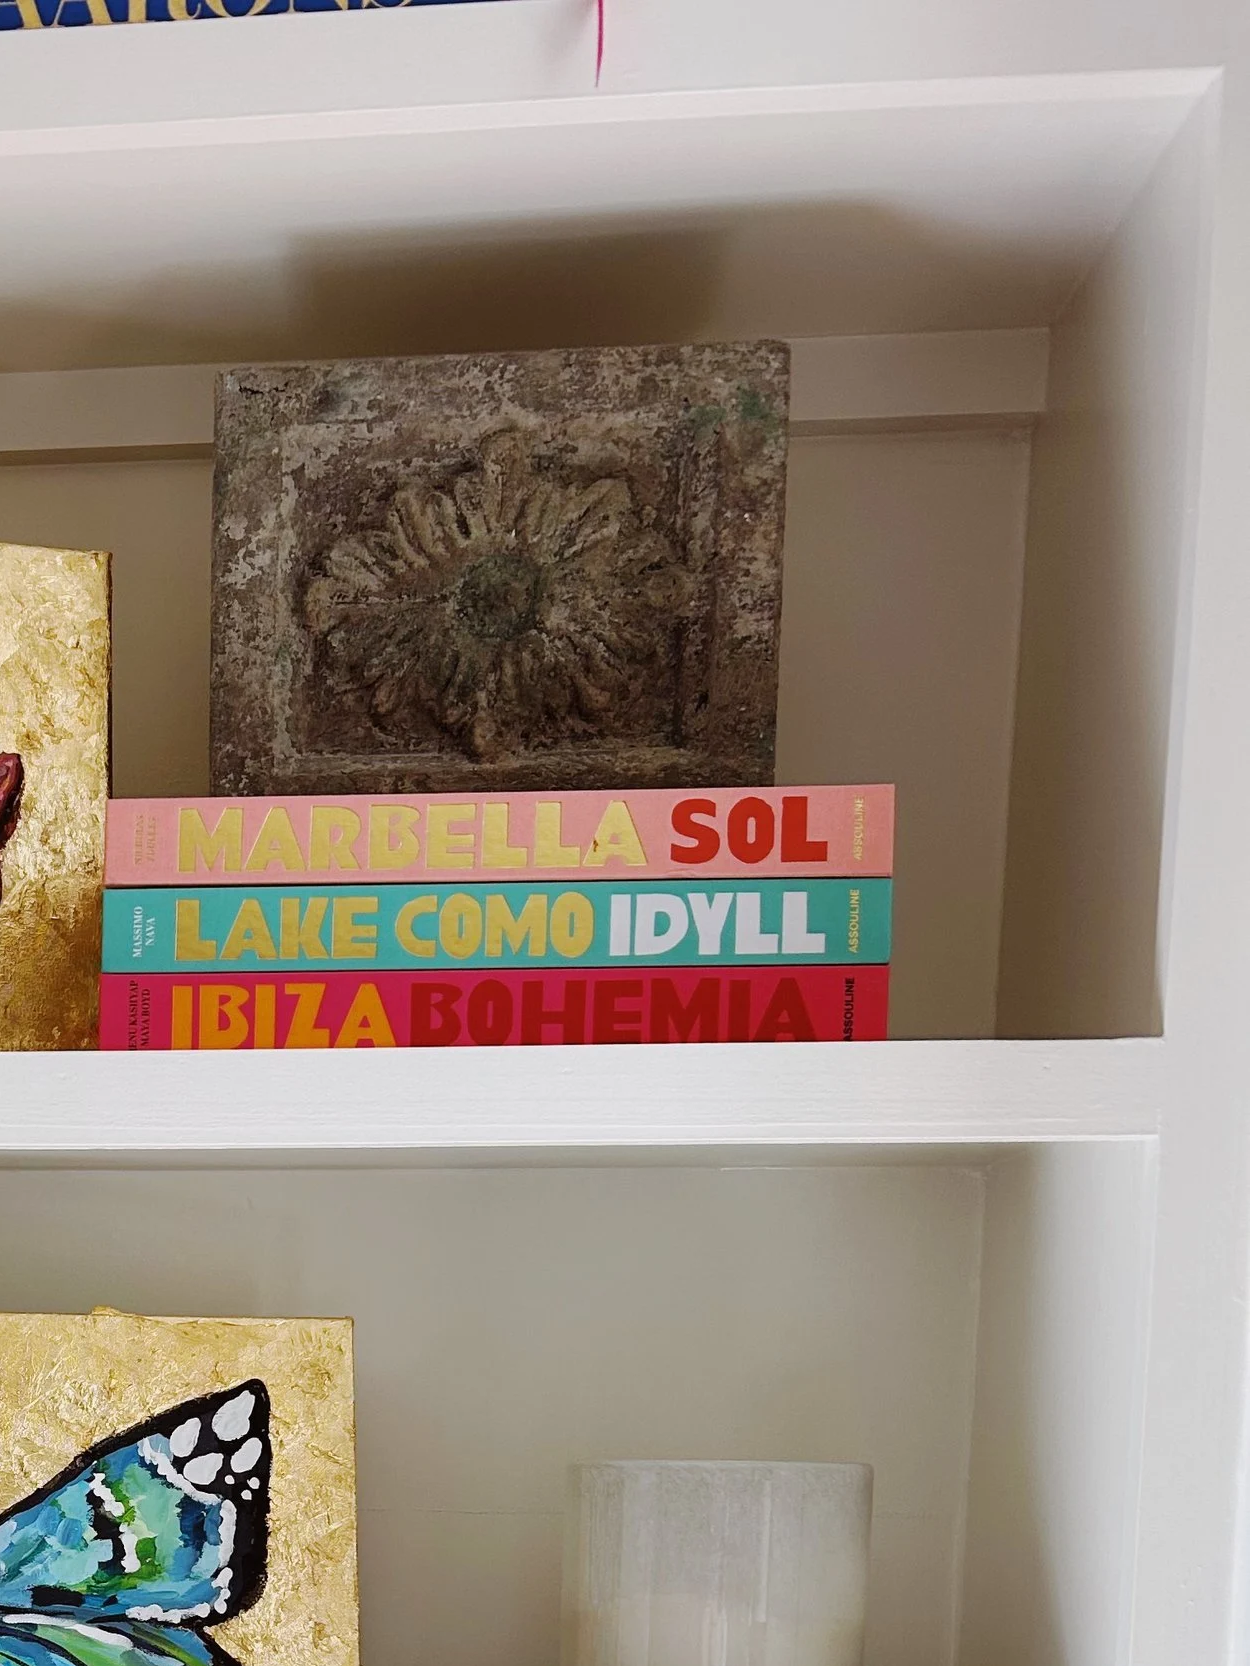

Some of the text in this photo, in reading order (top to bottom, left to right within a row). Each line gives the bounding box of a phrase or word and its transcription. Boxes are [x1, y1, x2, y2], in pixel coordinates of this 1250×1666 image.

[178, 800, 649, 873] MARBELLA
[670, 796, 829, 865] SOL
[853, 796, 865, 861] ASSOULINE
[132, 906, 144, 959] MASSIMO
[145, 916, 157, 947] NAVA
[174, 891, 827, 962] LAKE COMO IDYLL
[846, 889, 861, 954] ASSOULINE
[140, 988, 152, 1047] MAYA BOYD
[171, 977, 818, 1051] IBIZA BOHEMIA
